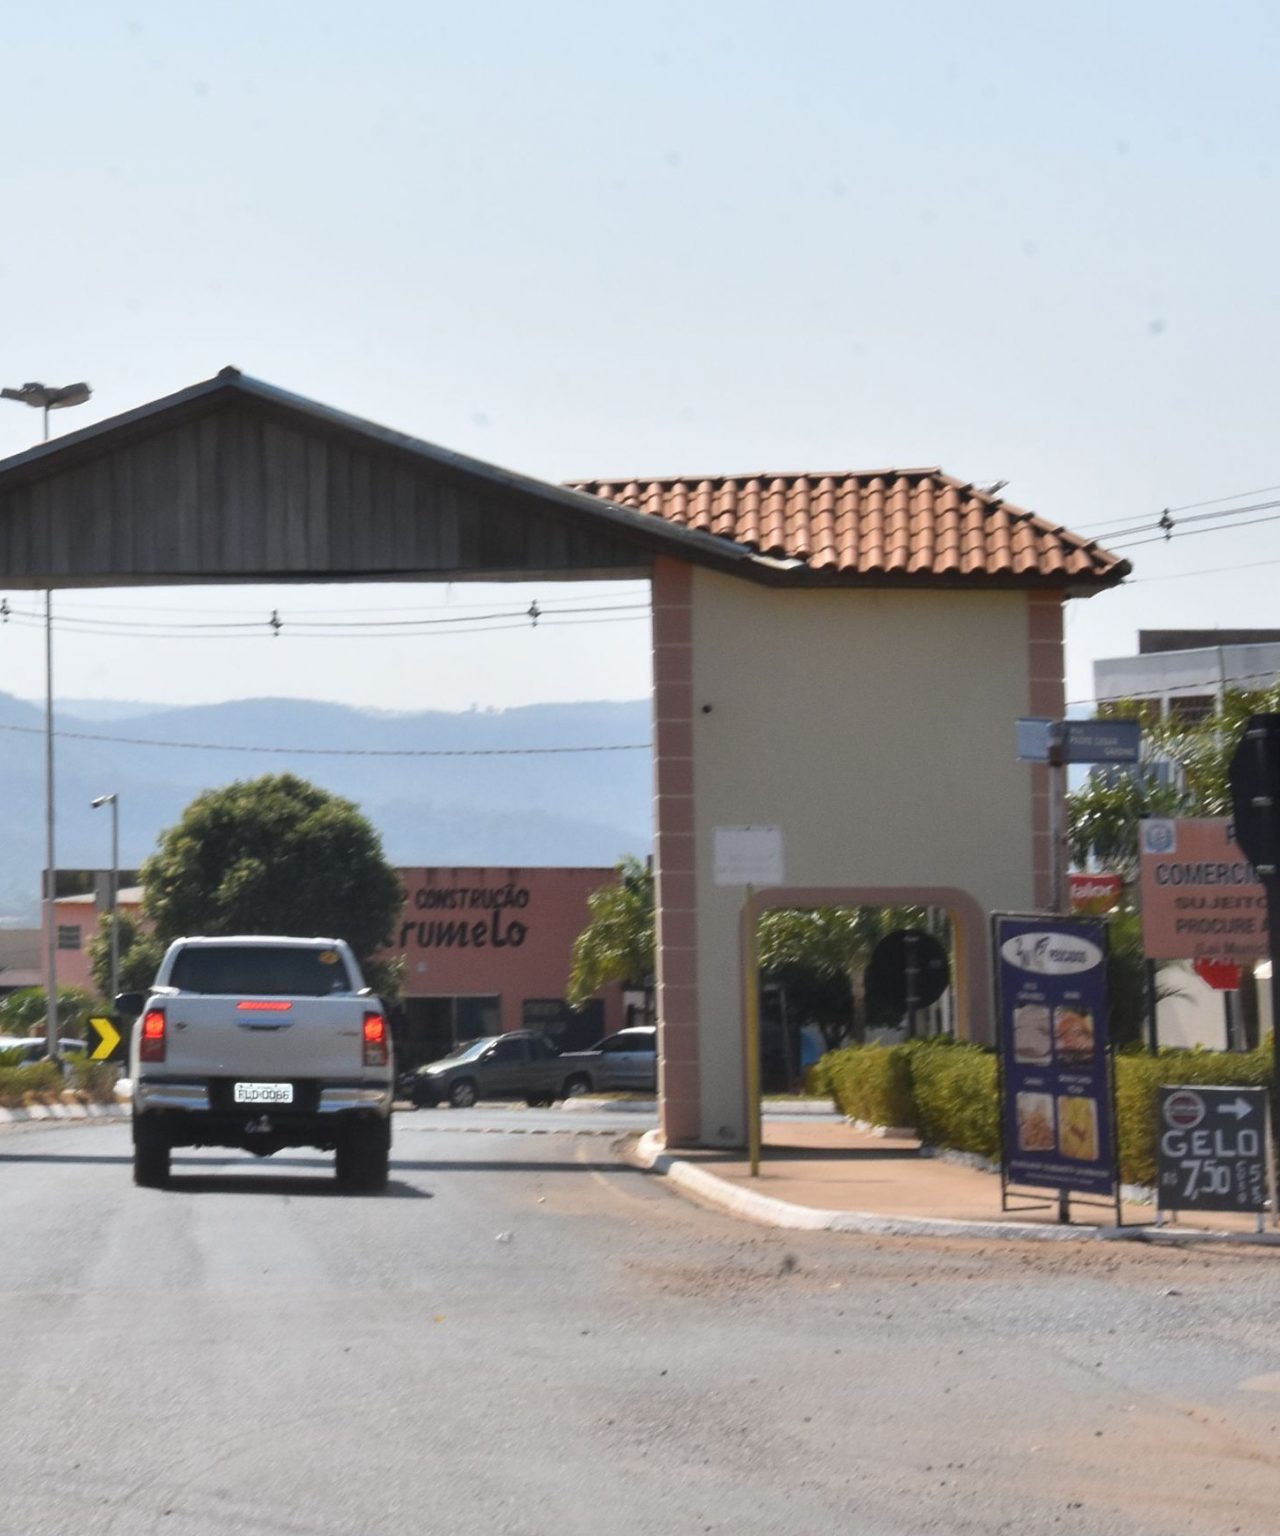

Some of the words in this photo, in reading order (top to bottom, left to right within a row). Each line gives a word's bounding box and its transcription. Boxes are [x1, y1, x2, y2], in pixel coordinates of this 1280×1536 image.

[415, 882, 530, 911] CONSTRUÇÃO
[1175, 918, 1256, 935] PROCURE
[1161, 1129, 1258, 1158] GELO
[1180, 1160, 1231, 1201] 7,50
